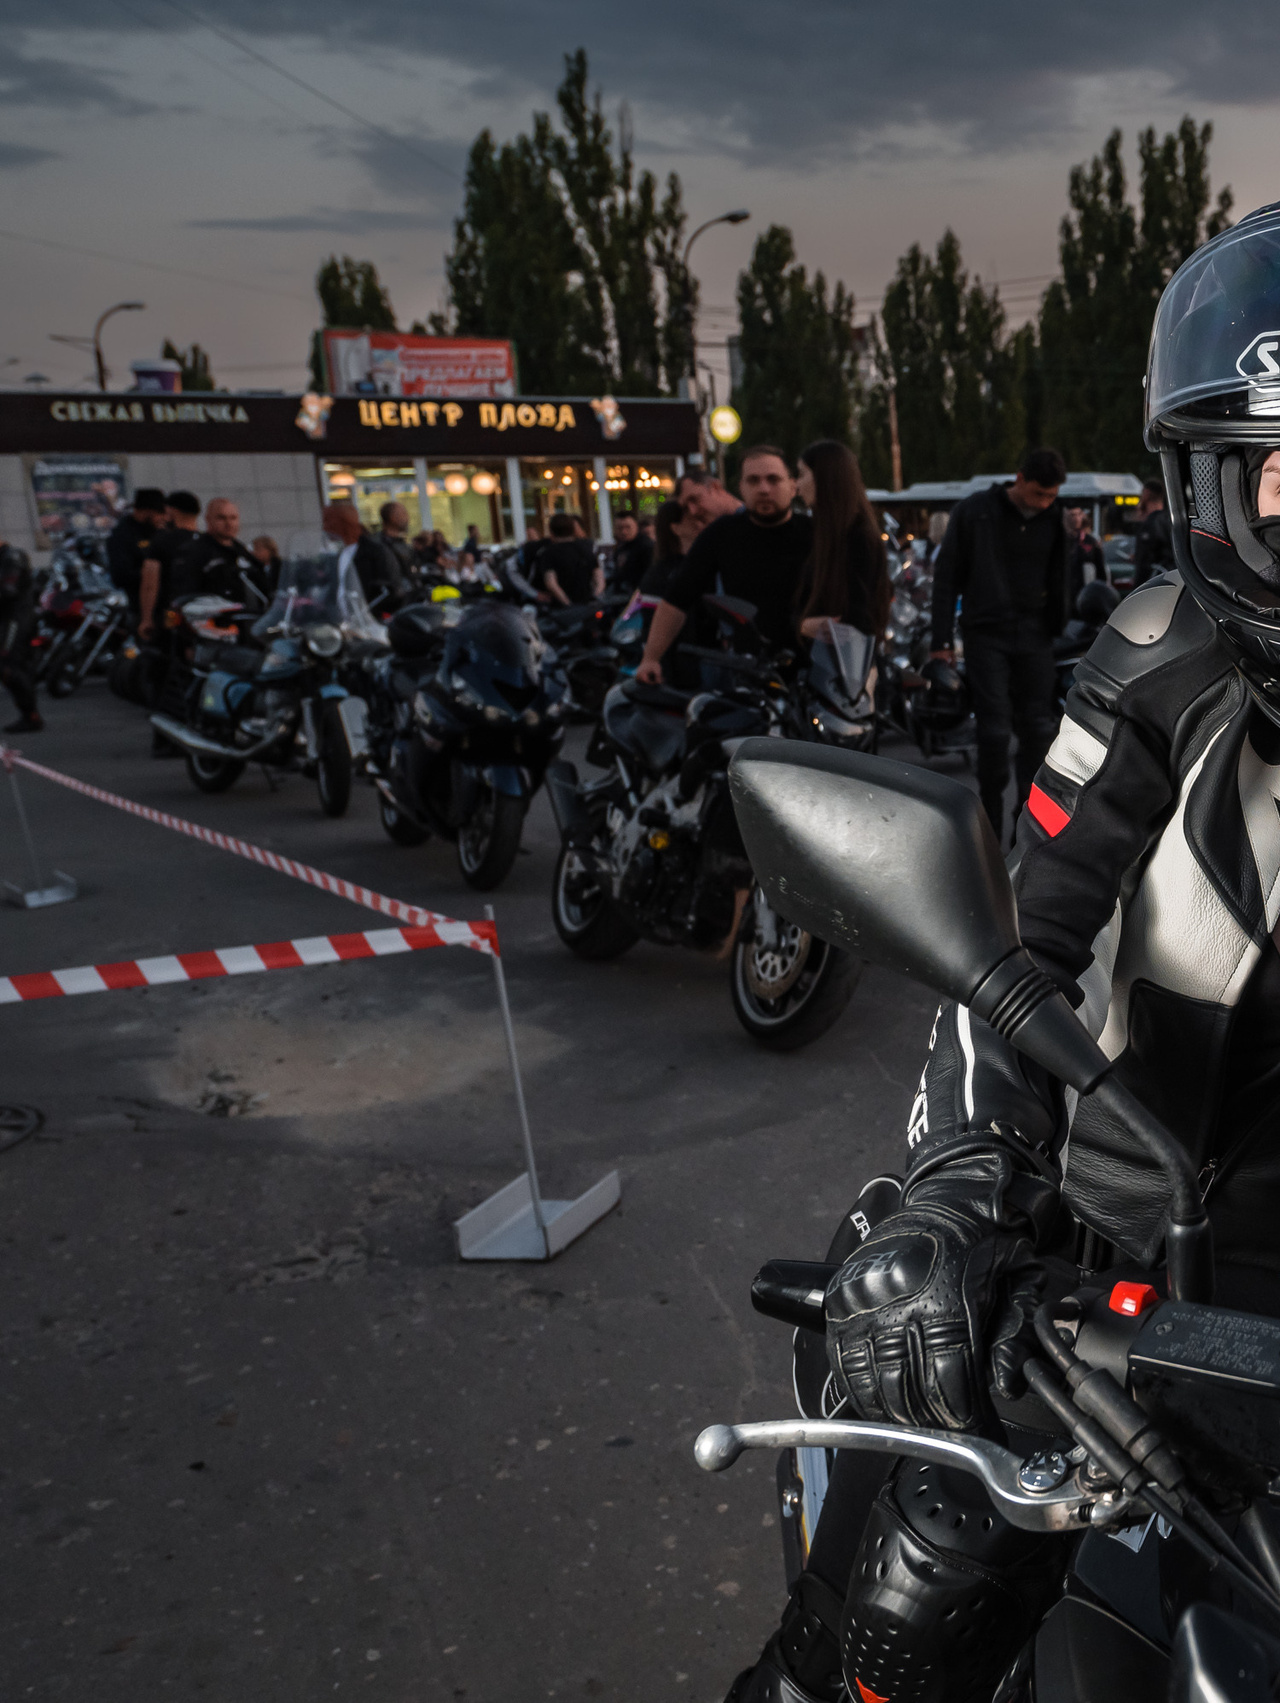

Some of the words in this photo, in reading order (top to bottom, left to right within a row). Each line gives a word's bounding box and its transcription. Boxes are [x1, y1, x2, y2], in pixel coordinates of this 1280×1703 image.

[51, 402, 144, 422] СВЕЖАЯ
[152, 404, 249, 423] ВЫПЕЧКА
[358, 400, 464, 429] ЦЕНТР
[478, 403, 576, 431] ПЛОВА
[850, 1210, 872, 1242] DA
